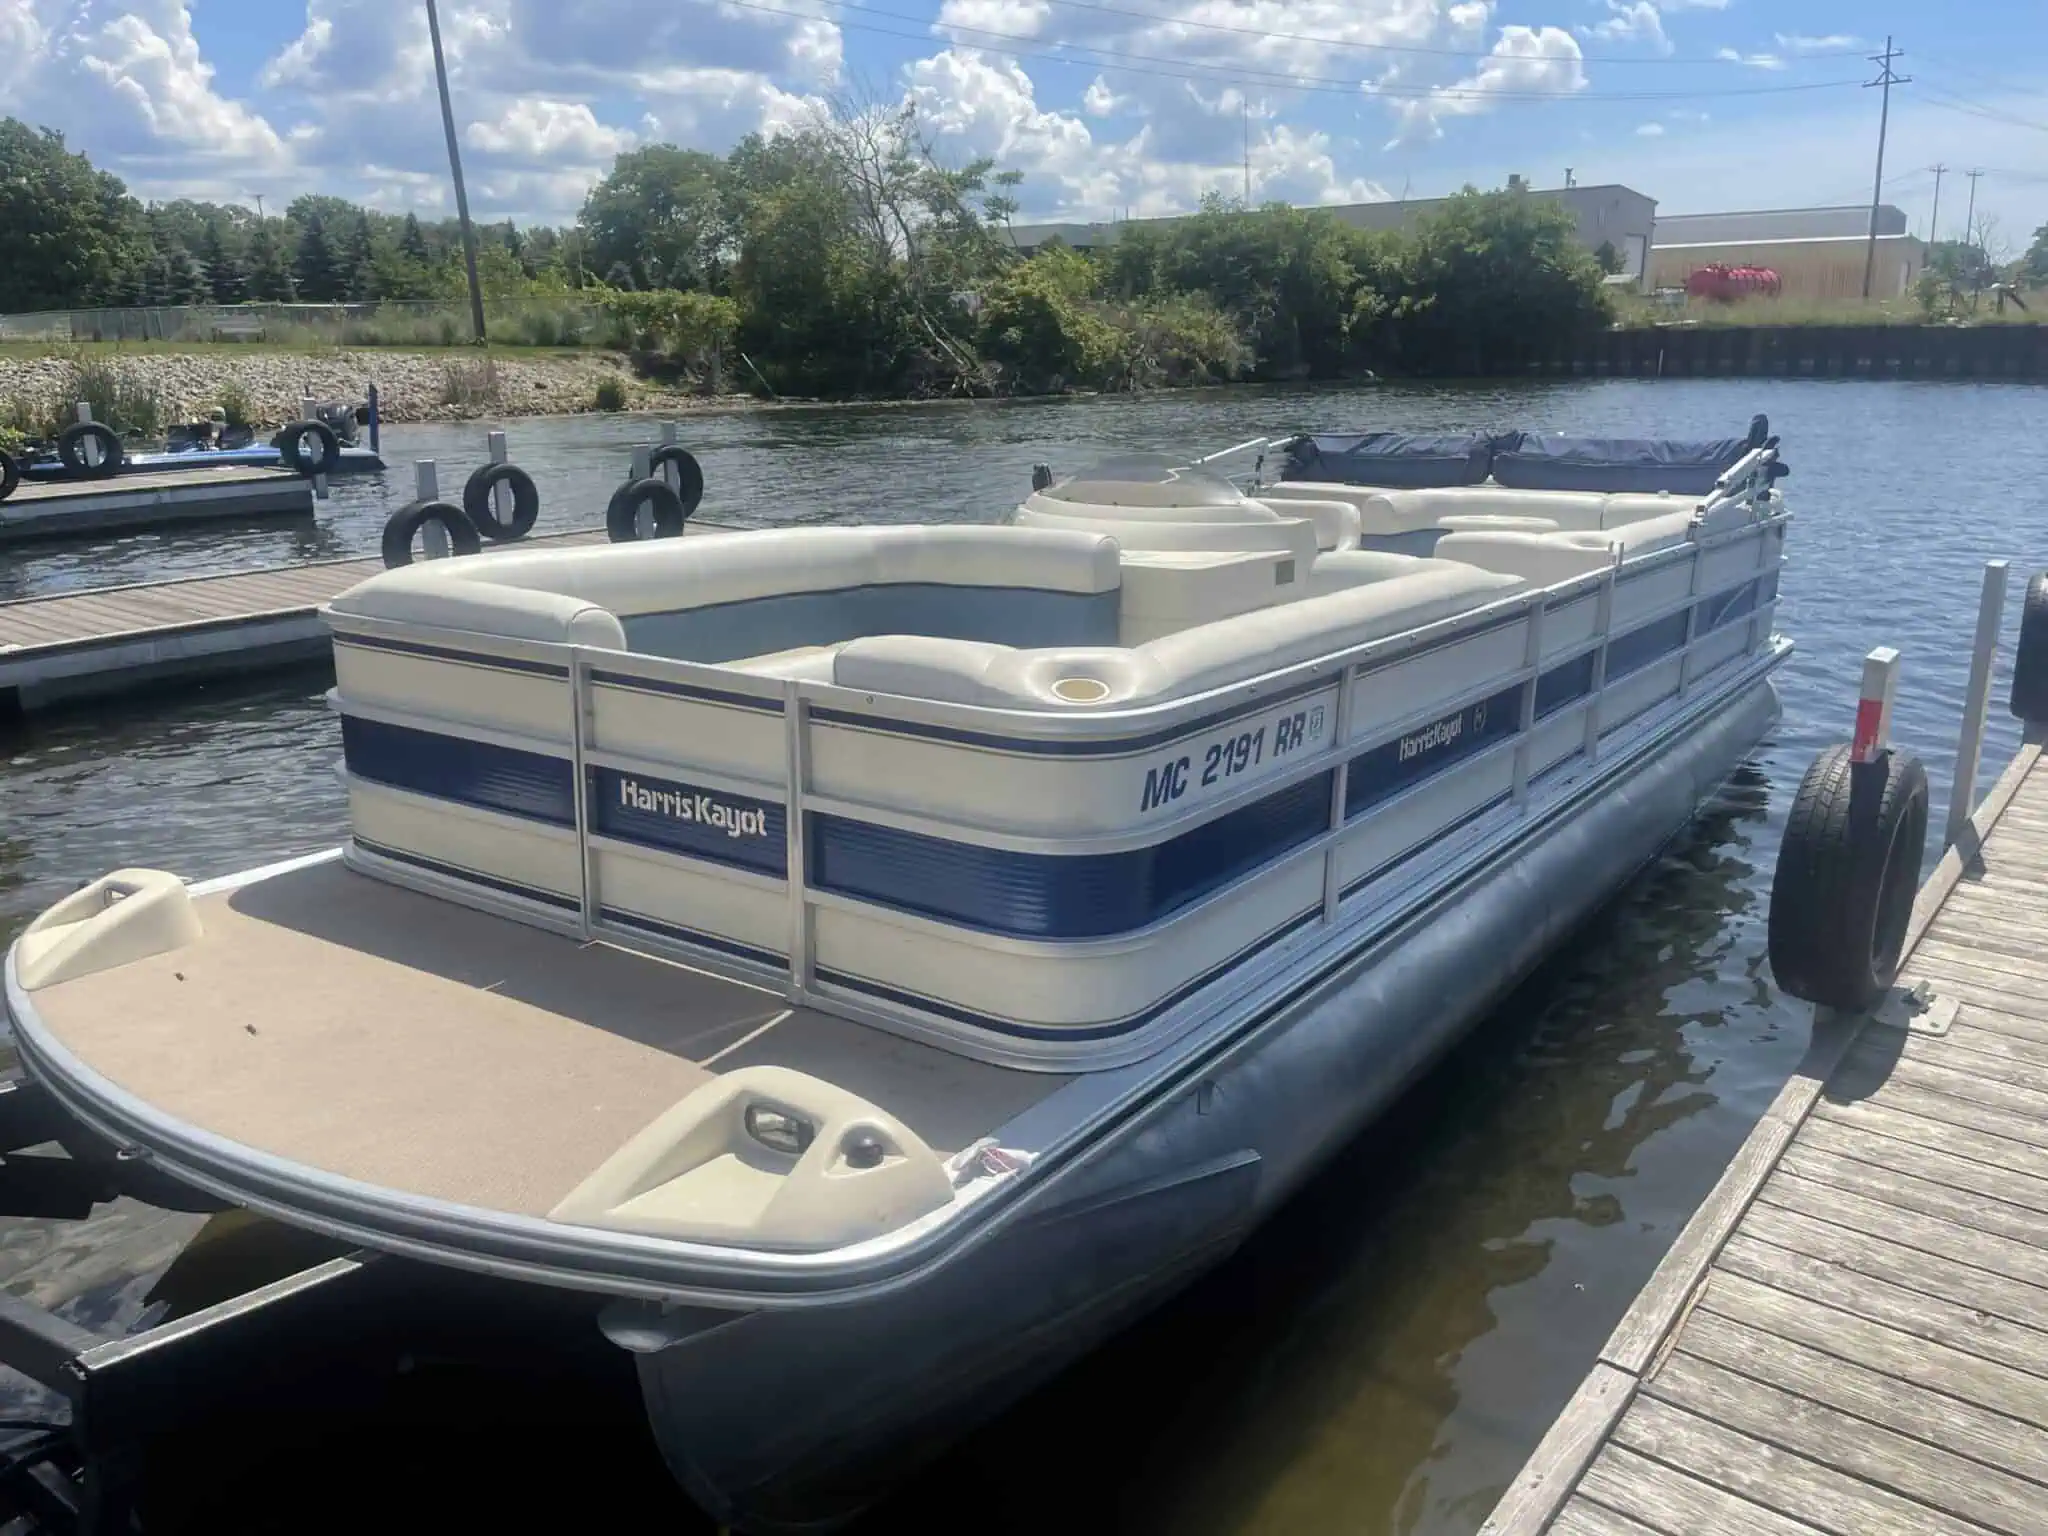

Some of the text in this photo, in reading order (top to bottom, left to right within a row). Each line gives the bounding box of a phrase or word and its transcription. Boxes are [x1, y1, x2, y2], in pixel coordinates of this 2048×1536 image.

[1140, 756, 1190, 812] MC
[1201, 727, 1266, 787] 2191
[1273, 711, 1306, 757] RR
[619, 779, 768, 838] HarrisKayot
